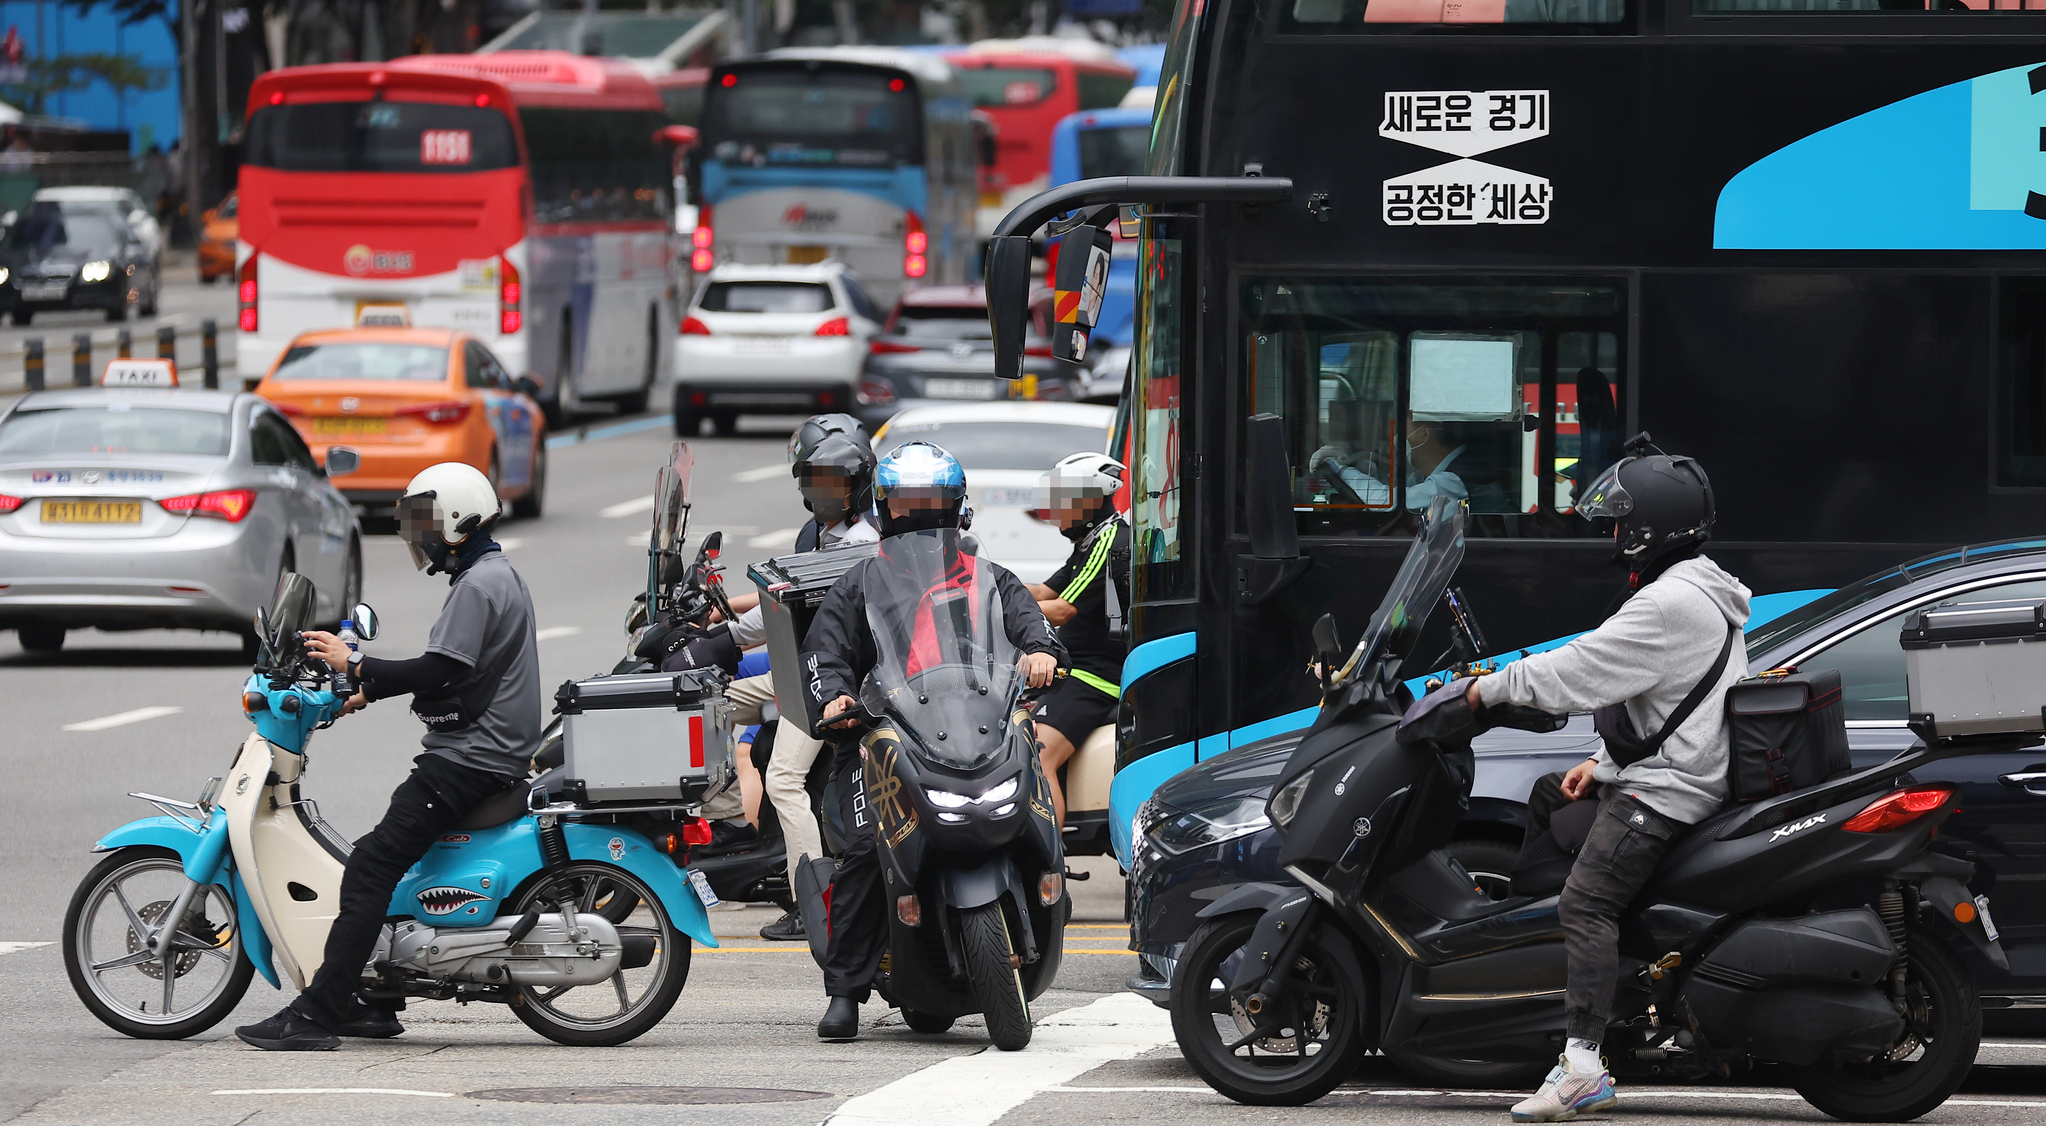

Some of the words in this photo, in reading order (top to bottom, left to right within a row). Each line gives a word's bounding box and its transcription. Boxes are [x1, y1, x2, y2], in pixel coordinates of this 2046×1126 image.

[1383, 95, 1472, 132] 새로운
[1489, 94, 1545, 131] 경기
[1387, 183, 1476, 221] 공정한
[1486, 183, 1549, 220] 세상
[118, 369, 157, 384] TAXI
[417, 712, 459, 725] Supreme
[852, 767, 868, 828] POLE
[1768, 813, 1827, 843] XMAX
